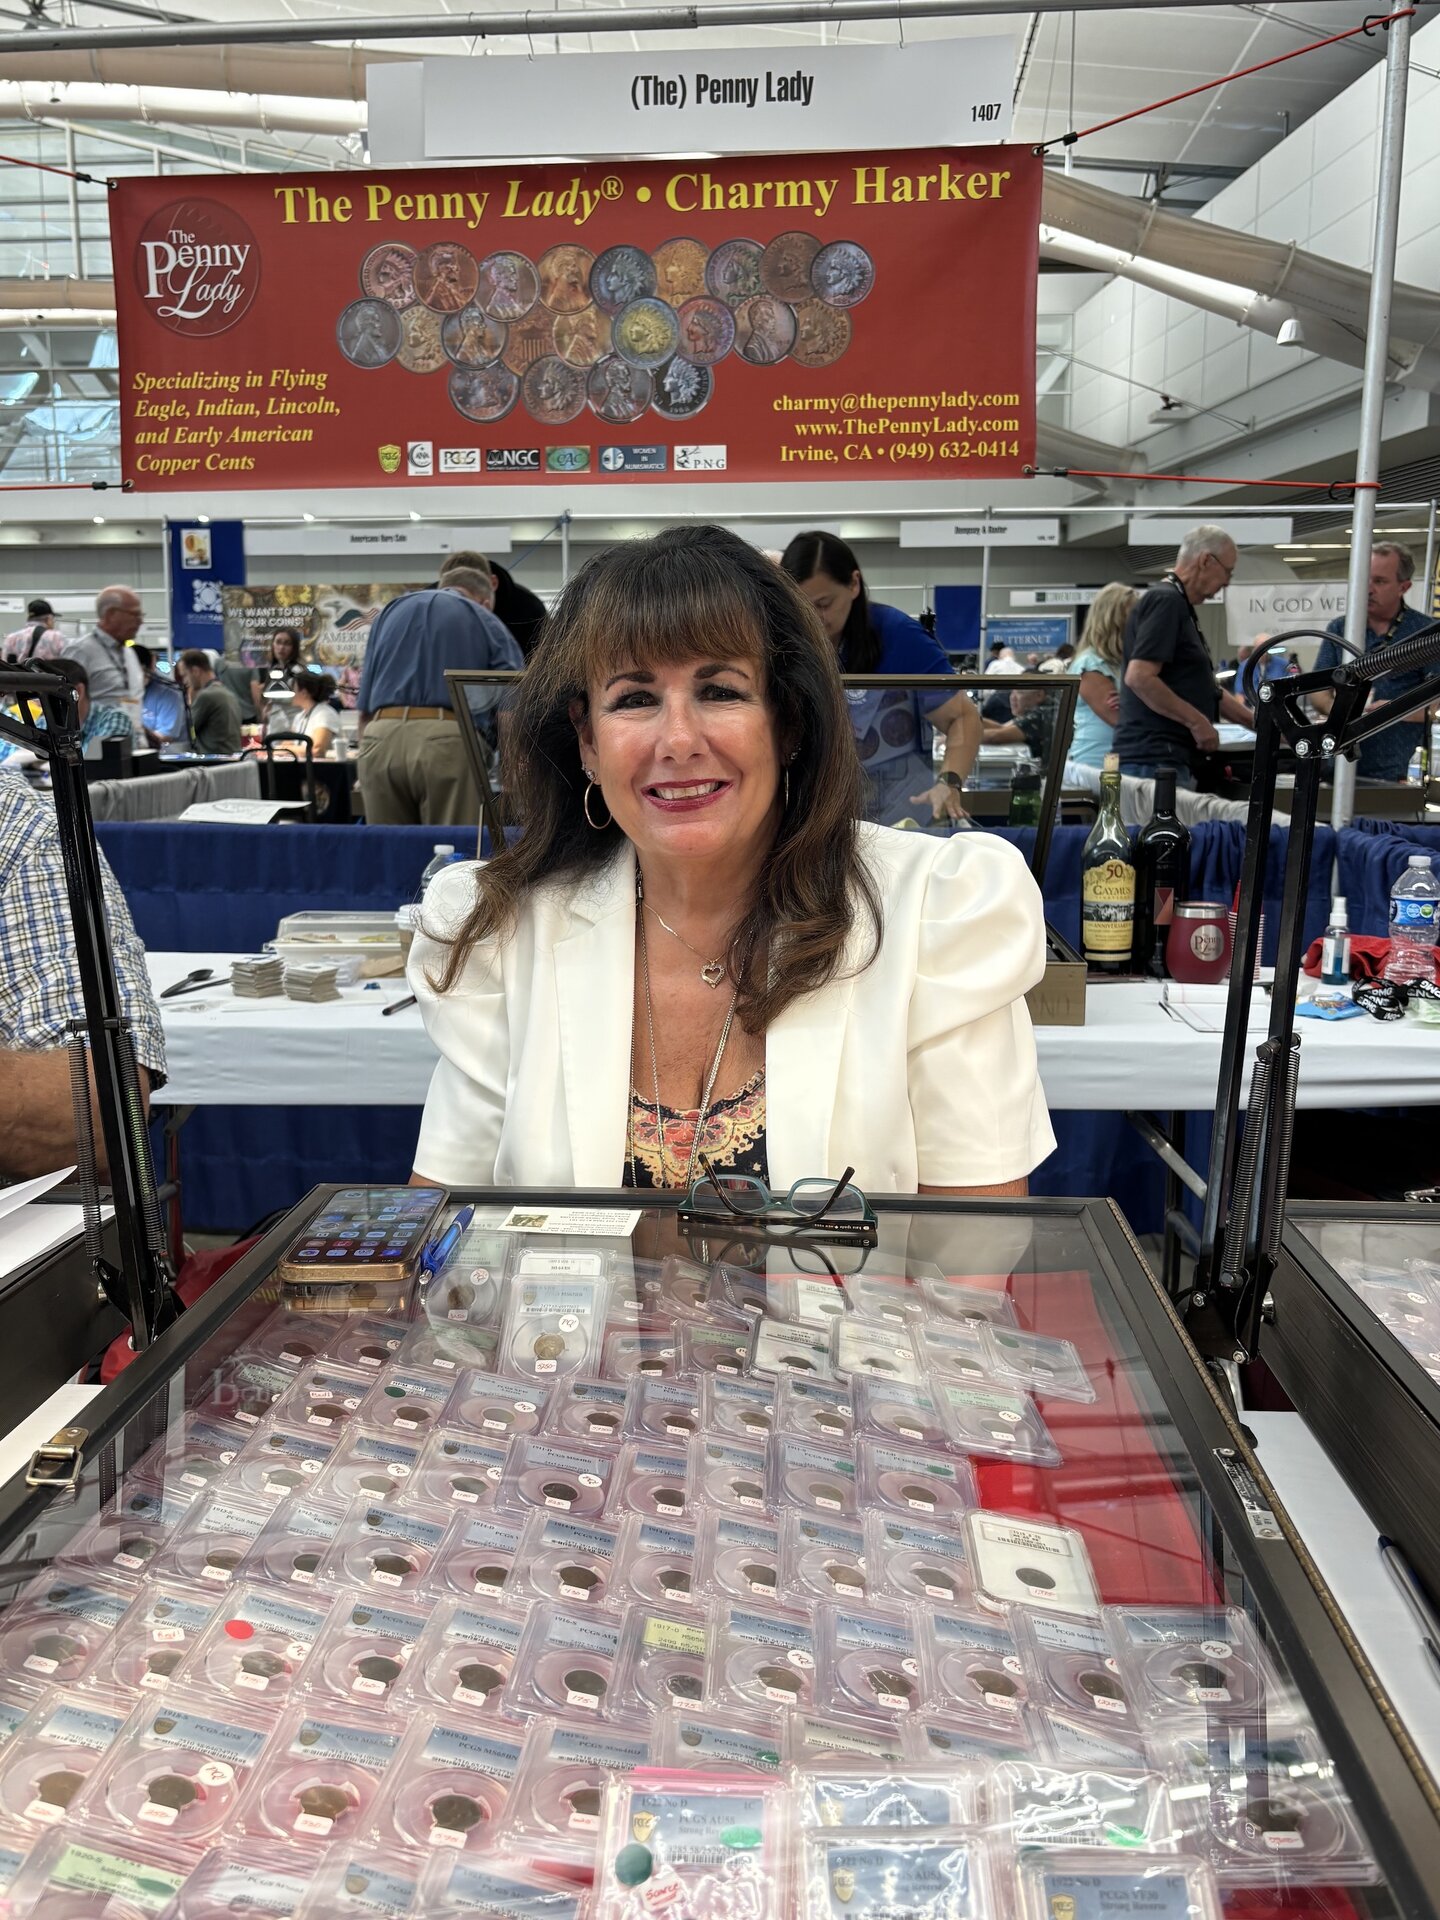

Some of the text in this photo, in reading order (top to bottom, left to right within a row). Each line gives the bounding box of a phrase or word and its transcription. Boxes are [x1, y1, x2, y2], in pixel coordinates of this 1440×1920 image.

[631, 70, 814, 110] (The) Penny Lady
[971, 103, 1002, 122] 1407
[274, 186, 353, 224] The
[365, 184, 491, 229] Penny
[665, 172, 839, 217] Charmy
[851, 164, 1011, 206] Harker
[169, 229, 195, 245] The
[141, 241, 251, 299] Penny
[157, 266, 246, 320] Lady
[133, 368, 328, 394] Specializing in Flying
[134, 397, 341, 421] Eagle, Indian, Lincoln,
[773, 391, 1020, 414] charmy@thepennylady.com
[795, 417, 1020, 438] www.ThePennyLady.com
[135, 426, 314, 448] and Early American
[444, 450, 477, 465] PCGS
[503, 450, 540, 466] NGC
[632, 447, 657, 455] WOMEN
[780, 441, 1019, 464] Irvine, CA (949) 632-0414
[136, 454, 256, 475] Copper Cents
[228, 606, 314, 617] WE WANT TO BUY
[1250, 597, 1345, 613] IN GOD WE
[239, 618, 304, 628] YOUR COINS!
[1106, 864, 1124, 880] 50
[1093, 884, 1131, 896] CAYMUS
[382, 1615, 404, 1624] PCGS
[476, 1621, 497, 1630] PCGS
[579, 1627, 600, 1636] PCGS
[653, 1622, 680, 1633] 1917-D
[1204, 1644, 1227, 1656] PQ!
[195, 1723, 218, 1735] PCGS
[458, 1741, 482, 1752] PCGS
[665, 1799, 678, 1808] No
[680, 1799, 688, 1808] D
[743, 1801, 755, 1810] 1C
[679, 1815, 707, 1824] PCGS
[678, 1826, 704, 1836] Strong
[70, 1848, 104, 1864] 1920-S
[859, 1856, 873, 1866] No
[875, 1856, 884, 1866] D
[1076, 1878, 1090, 1887] No
[1092, 1878, 1100, 1887] D
[1166, 1878, 1179, 1888] 1C
[1100, 1890, 1131, 1901] PCGS
